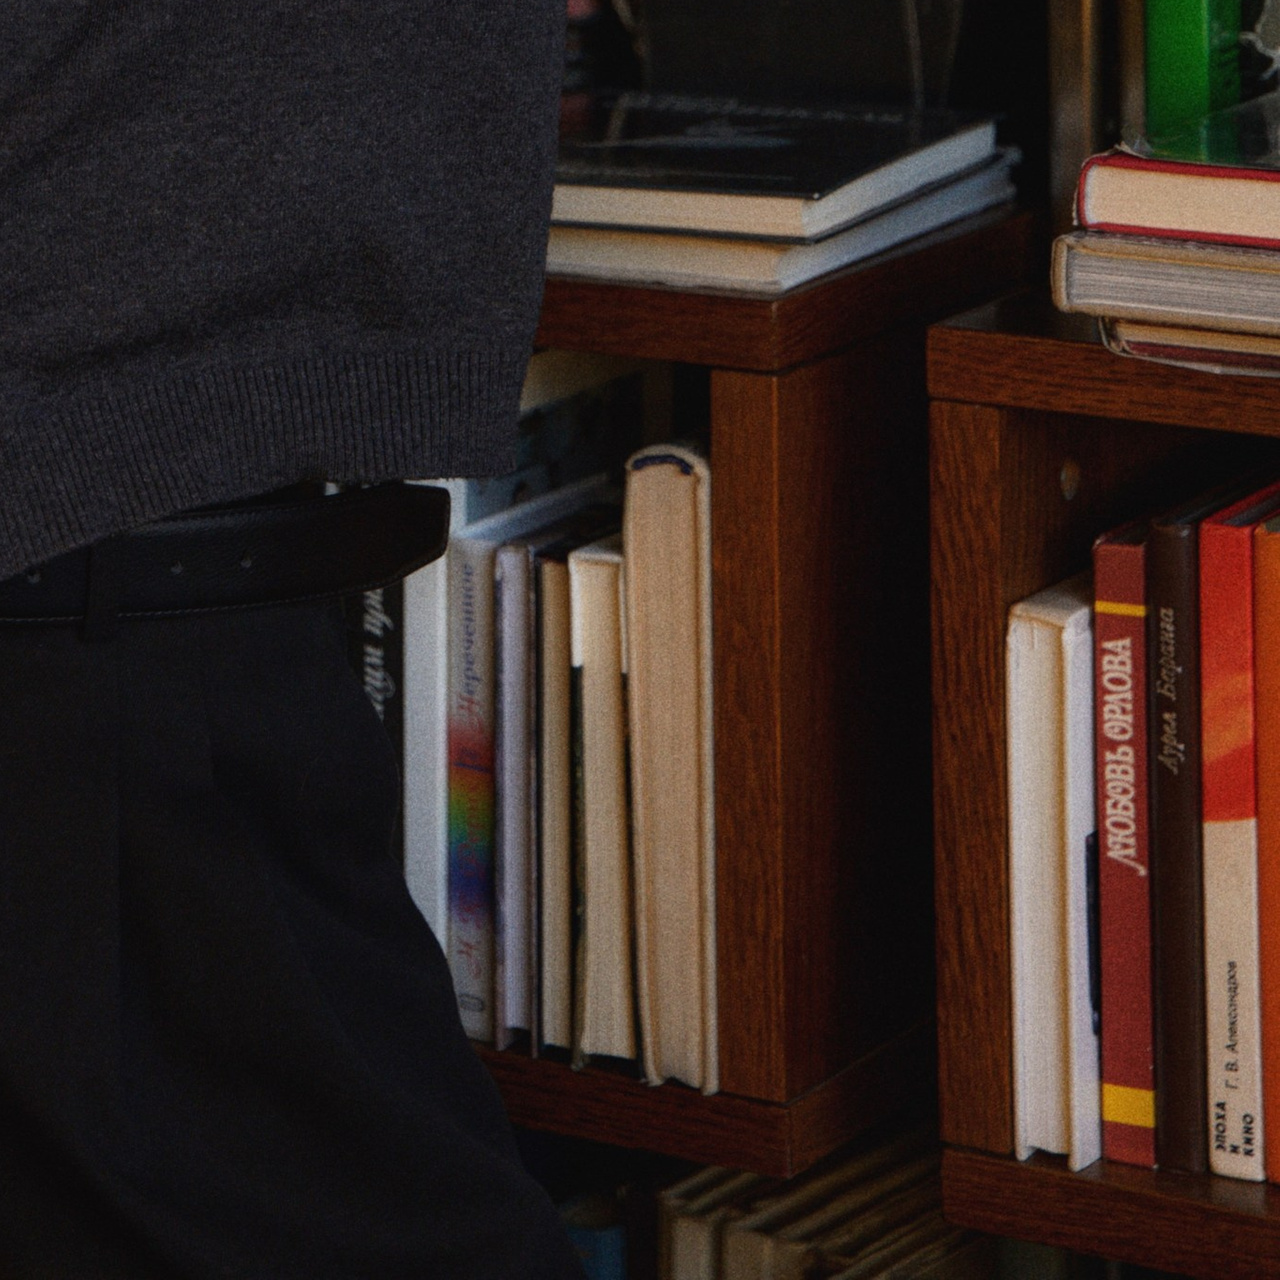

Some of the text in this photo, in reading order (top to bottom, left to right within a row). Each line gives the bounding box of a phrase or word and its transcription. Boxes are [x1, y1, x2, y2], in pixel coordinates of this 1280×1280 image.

[1101, 637, 1147, 877] ЛЮБОВЬ ОРЛОВА
[1224, 960, 1239, 1054] Александров
[1214, 1101, 1227, 1152] ЭПОХА
[1243, 1113, 1255, 1158] КИНО
